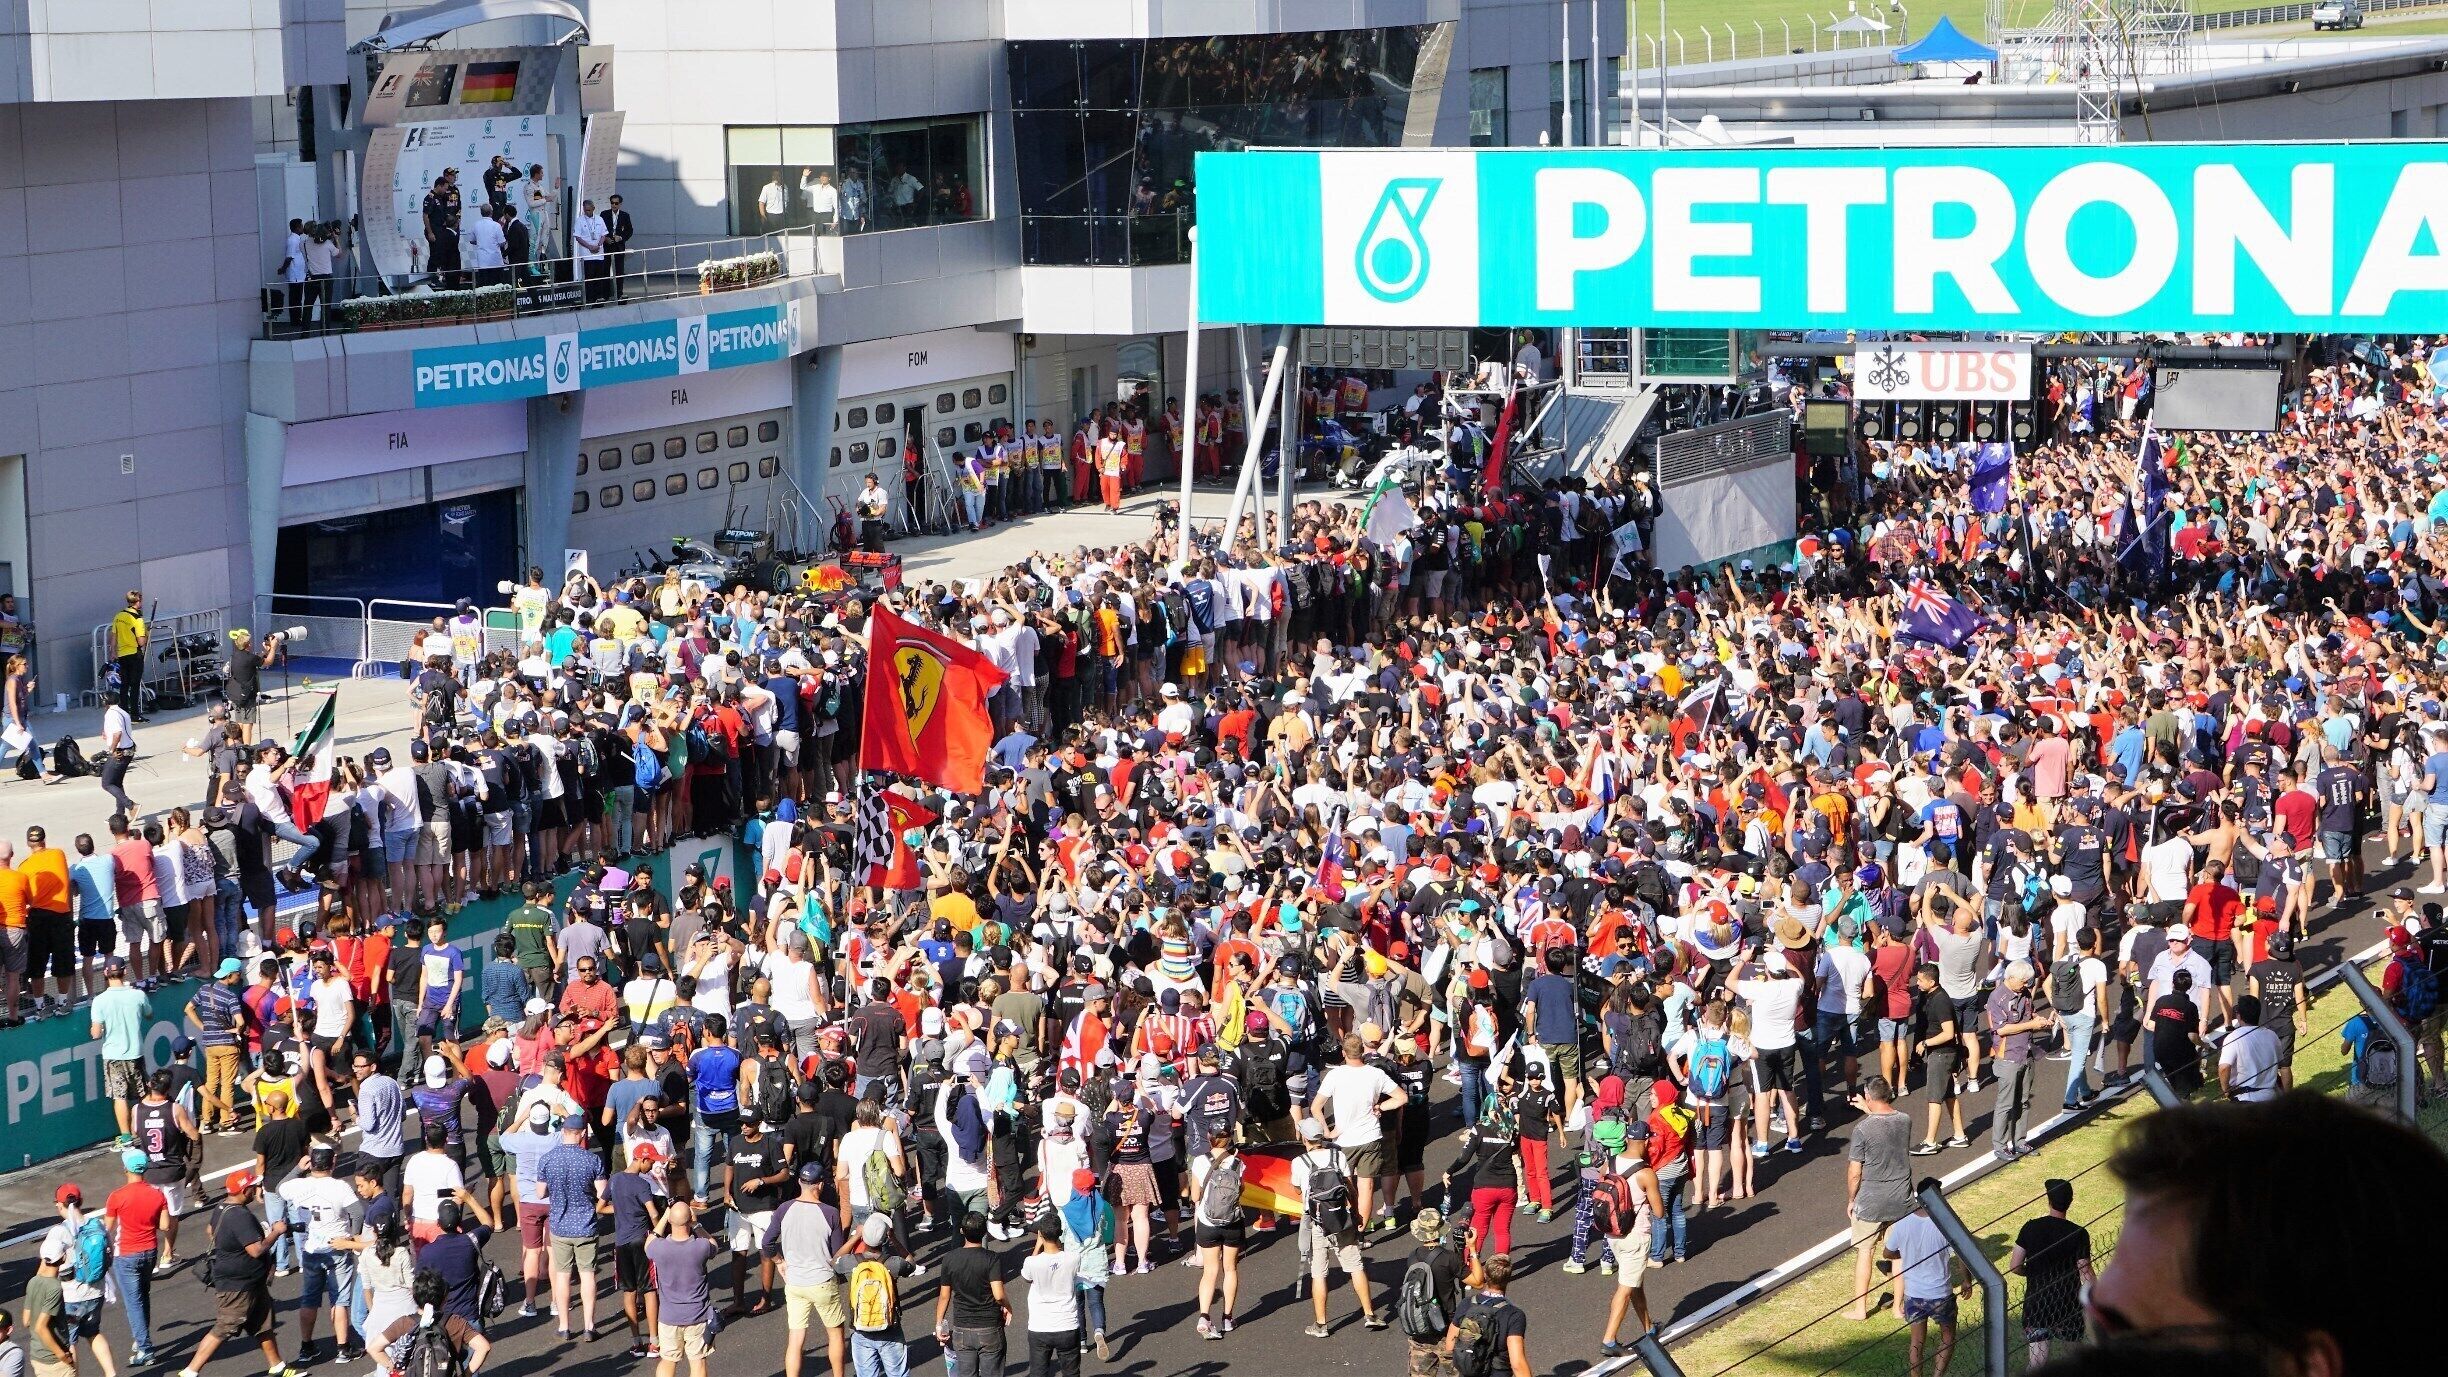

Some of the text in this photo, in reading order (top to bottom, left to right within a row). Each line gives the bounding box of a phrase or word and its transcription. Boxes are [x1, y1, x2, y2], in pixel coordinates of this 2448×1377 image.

[709, 318, 788, 354] PETRONAS
[579, 335, 678, 372] PETRONAS
[908, 350, 928, 368] FOM
[416, 353, 545, 392] PETRONAS
[1917, 350, 2017, 393] UBS
[671, 388, 689, 406] FIA
[389, 431, 409, 451] FIA
[146, 1128, 163, 1153] 3
